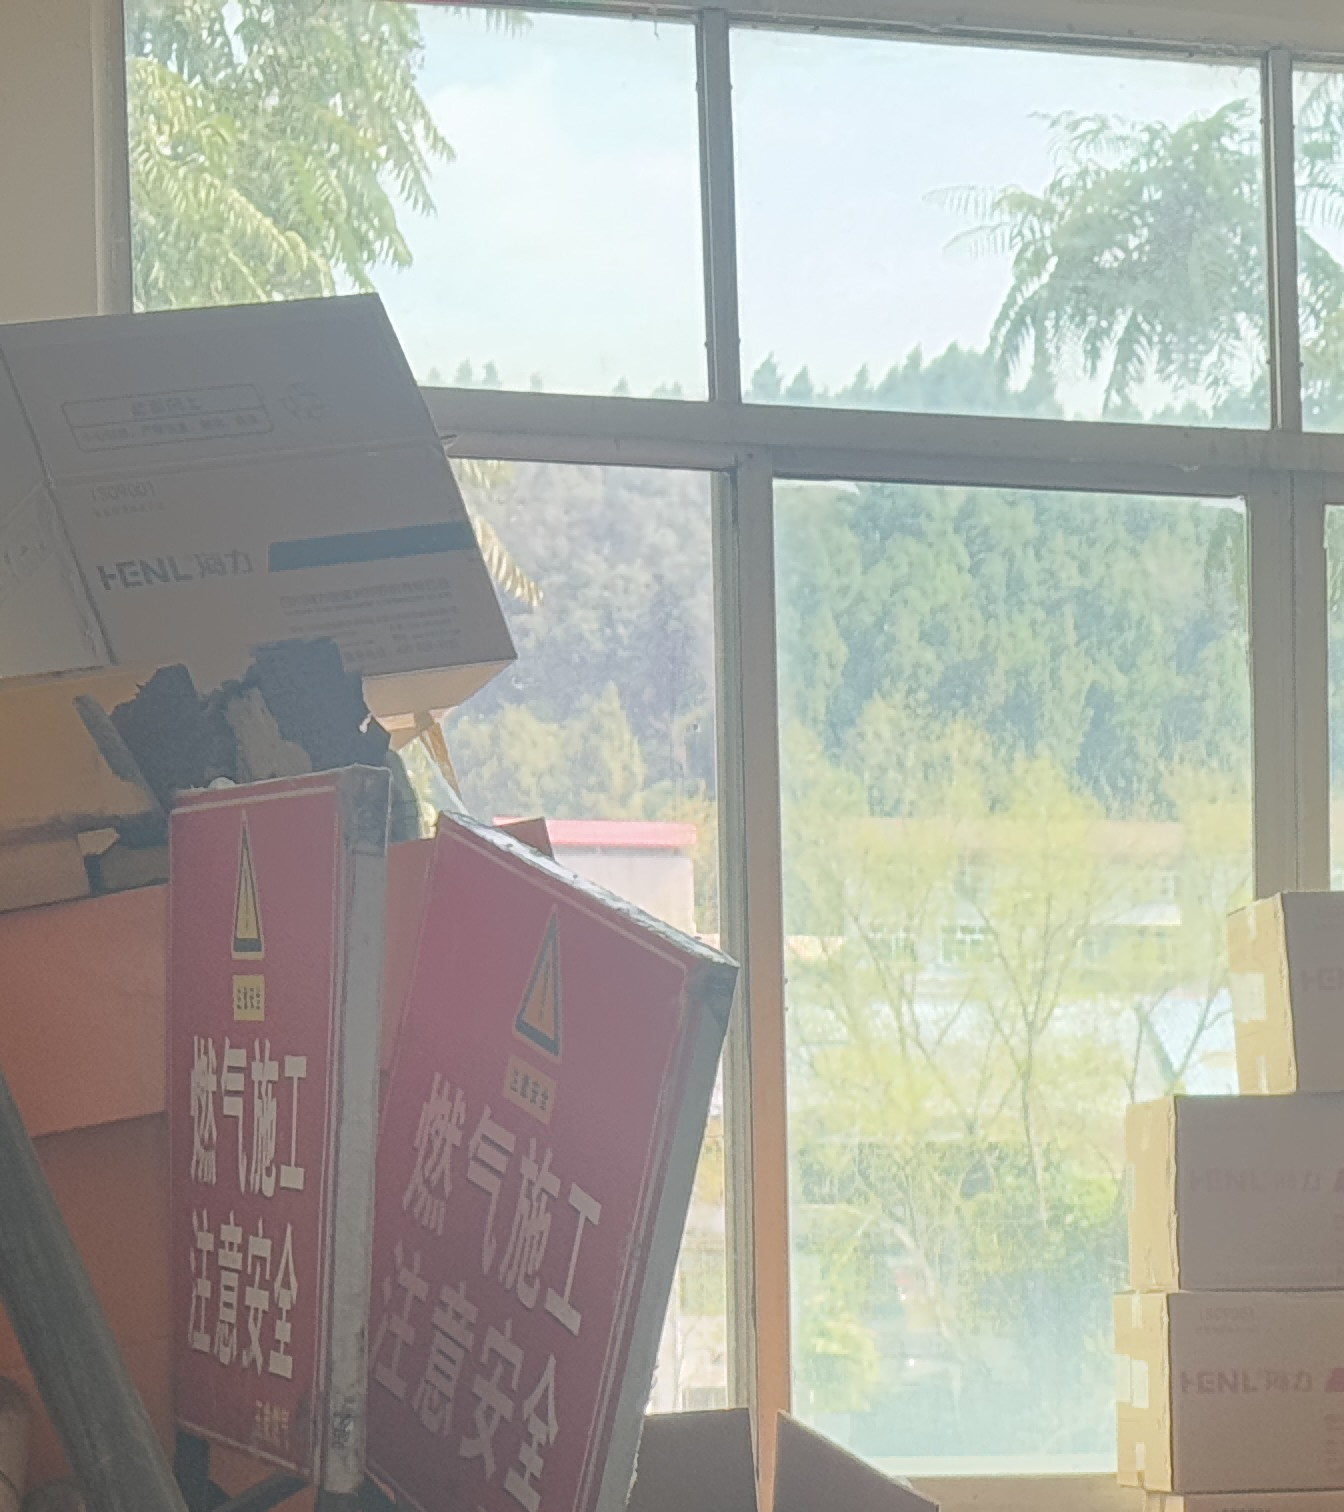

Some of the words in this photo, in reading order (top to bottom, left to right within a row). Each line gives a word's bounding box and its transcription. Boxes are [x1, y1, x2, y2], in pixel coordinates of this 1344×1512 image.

[187, 1034, 309, 1199] 燃气施工
[400, 1069, 604, 1337] 燃气施工
[186, 1208, 298, 1381] 注意安全
